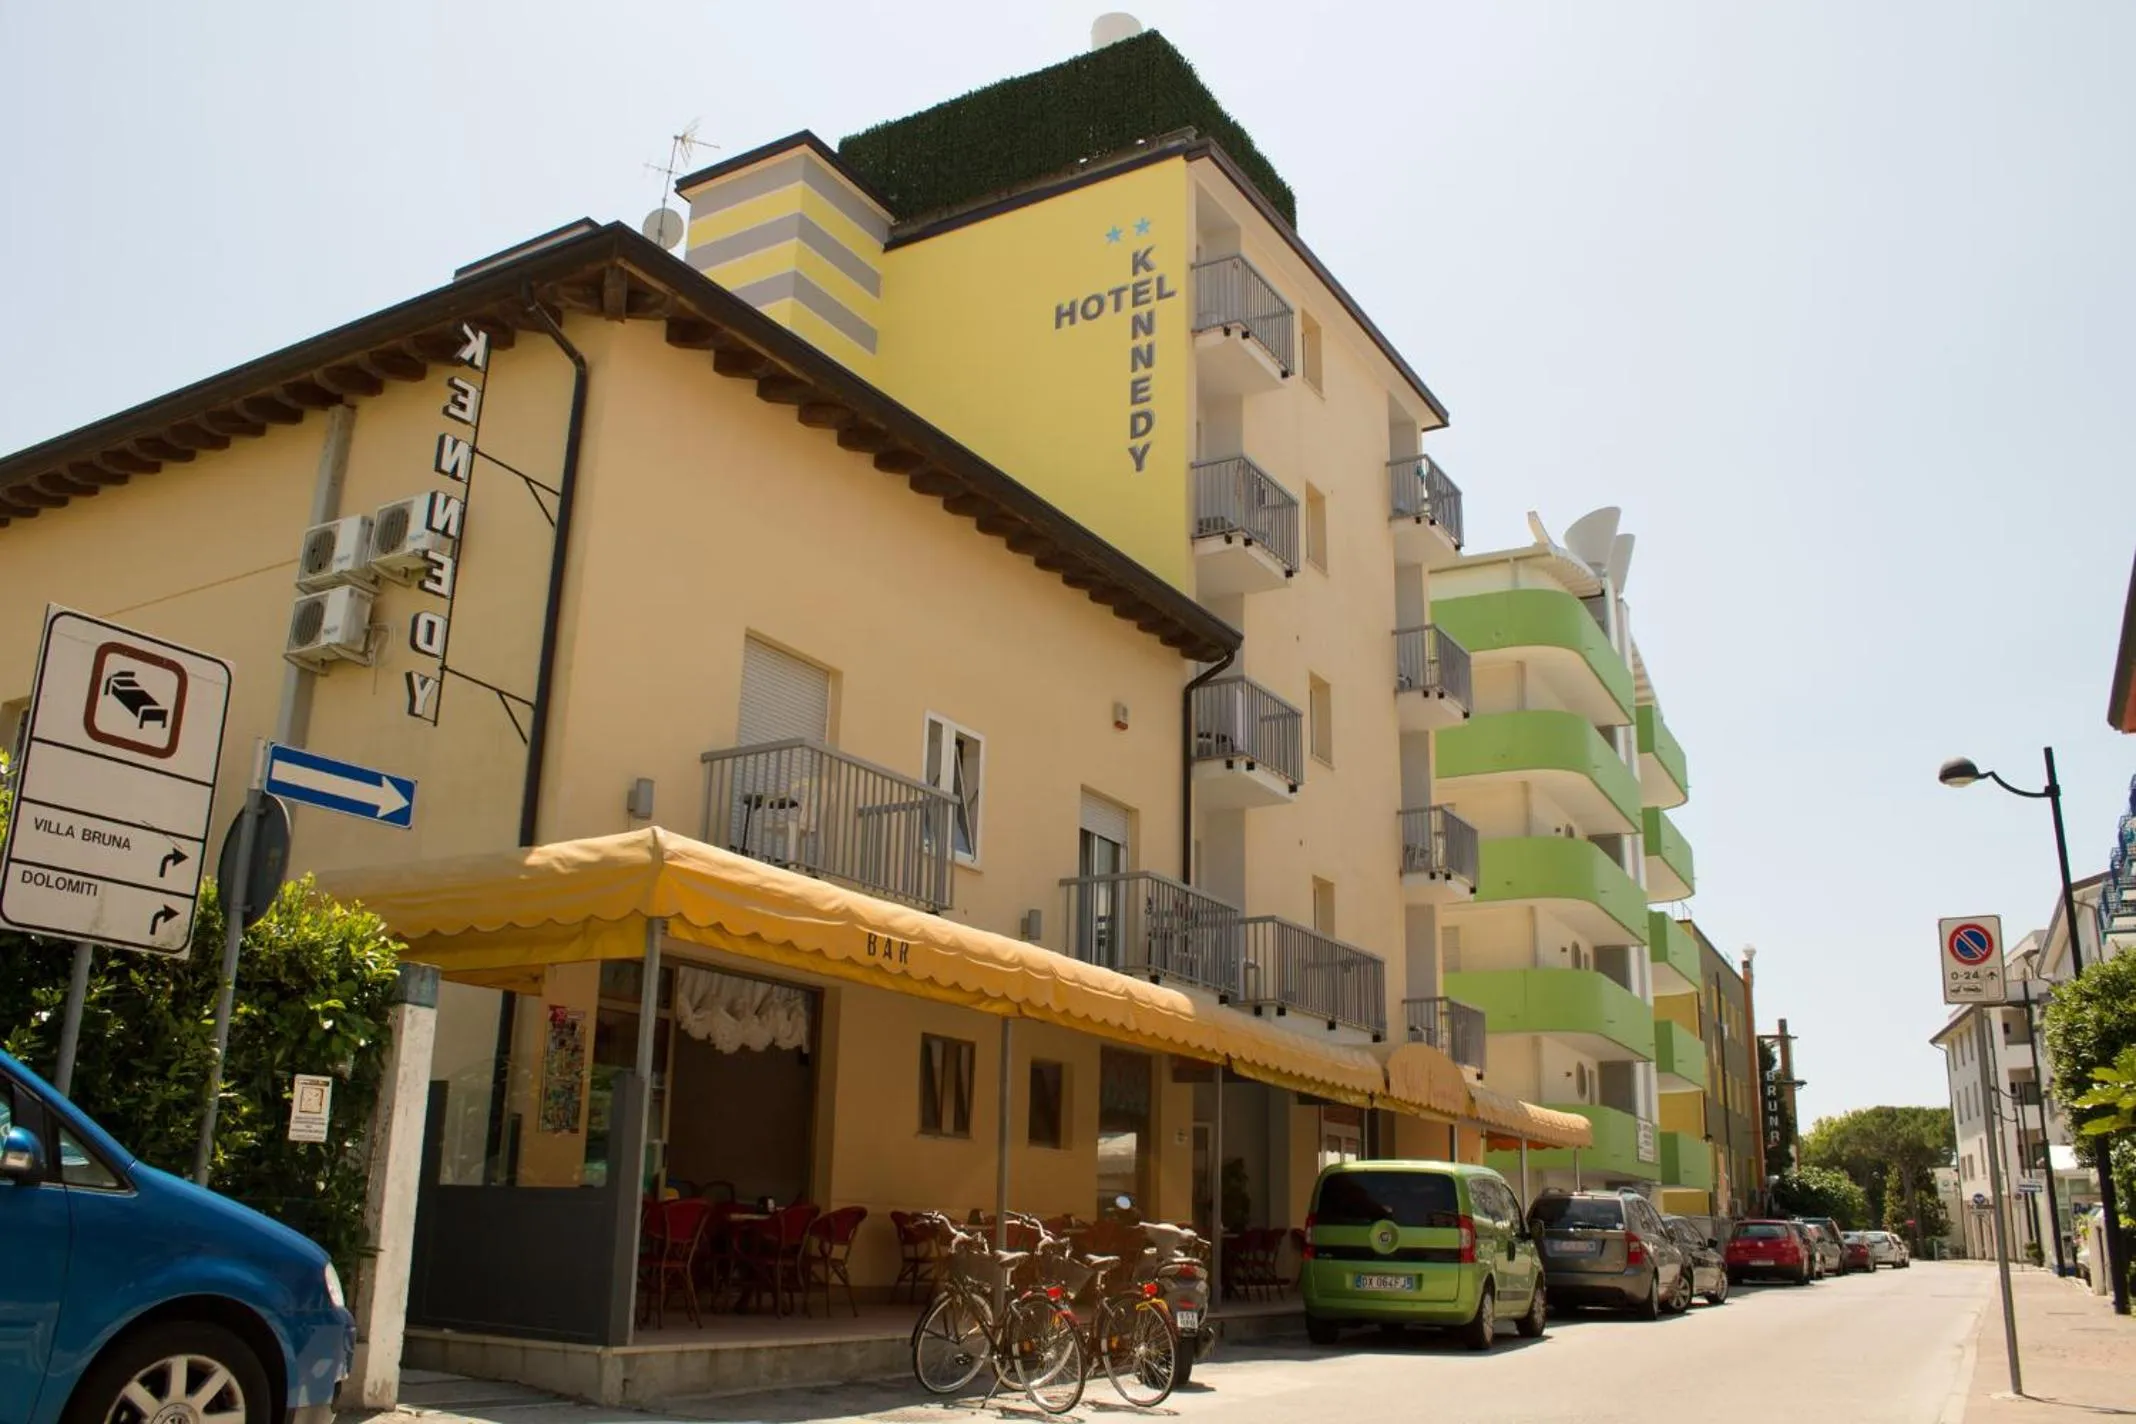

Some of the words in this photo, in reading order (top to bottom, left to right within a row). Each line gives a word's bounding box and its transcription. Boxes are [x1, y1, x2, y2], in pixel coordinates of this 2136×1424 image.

[1054, 273, 1178, 330] HOTEL
[1127, 245, 1156, 472] KENNEDY
[34, 816, 76, 839] VILLA
[81, 828, 132, 851] BRUNA
[20, 870, 99, 897] DOLOMITI
[867, 932, 909, 964] BAR
[1950, 971, 1980, 981] 0-24
